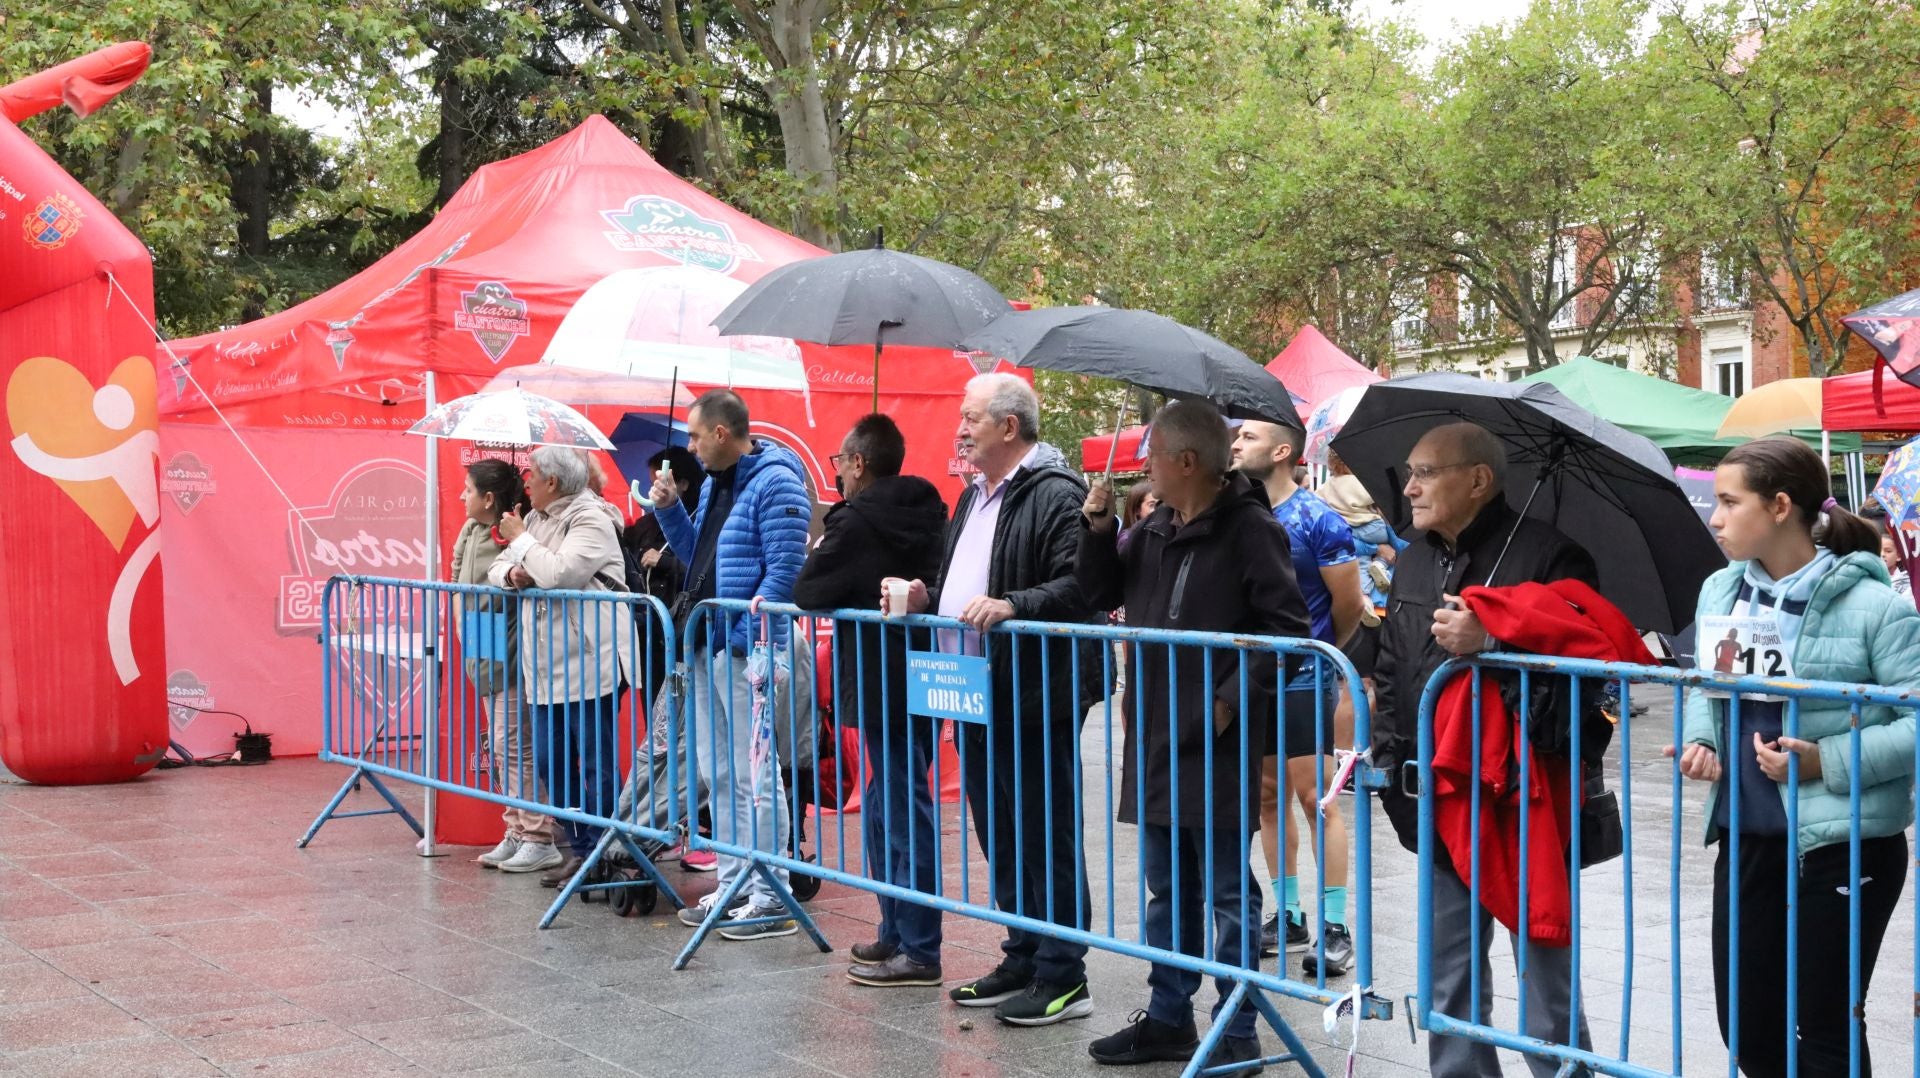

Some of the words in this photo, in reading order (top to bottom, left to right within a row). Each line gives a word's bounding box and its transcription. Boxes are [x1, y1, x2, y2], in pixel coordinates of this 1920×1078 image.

[636, 223, 721, 240] cuatro
[472, 304, 518, 317] cuatro
[457, 314, 527, 333] CANTONES
[910, 658, 959, 671] AYUNTAMIENTO
[921, 672, 929, 682] DE
[935, 673, 967, 686] PALENCIA
[927, 688, 984, 715] OBRAS
